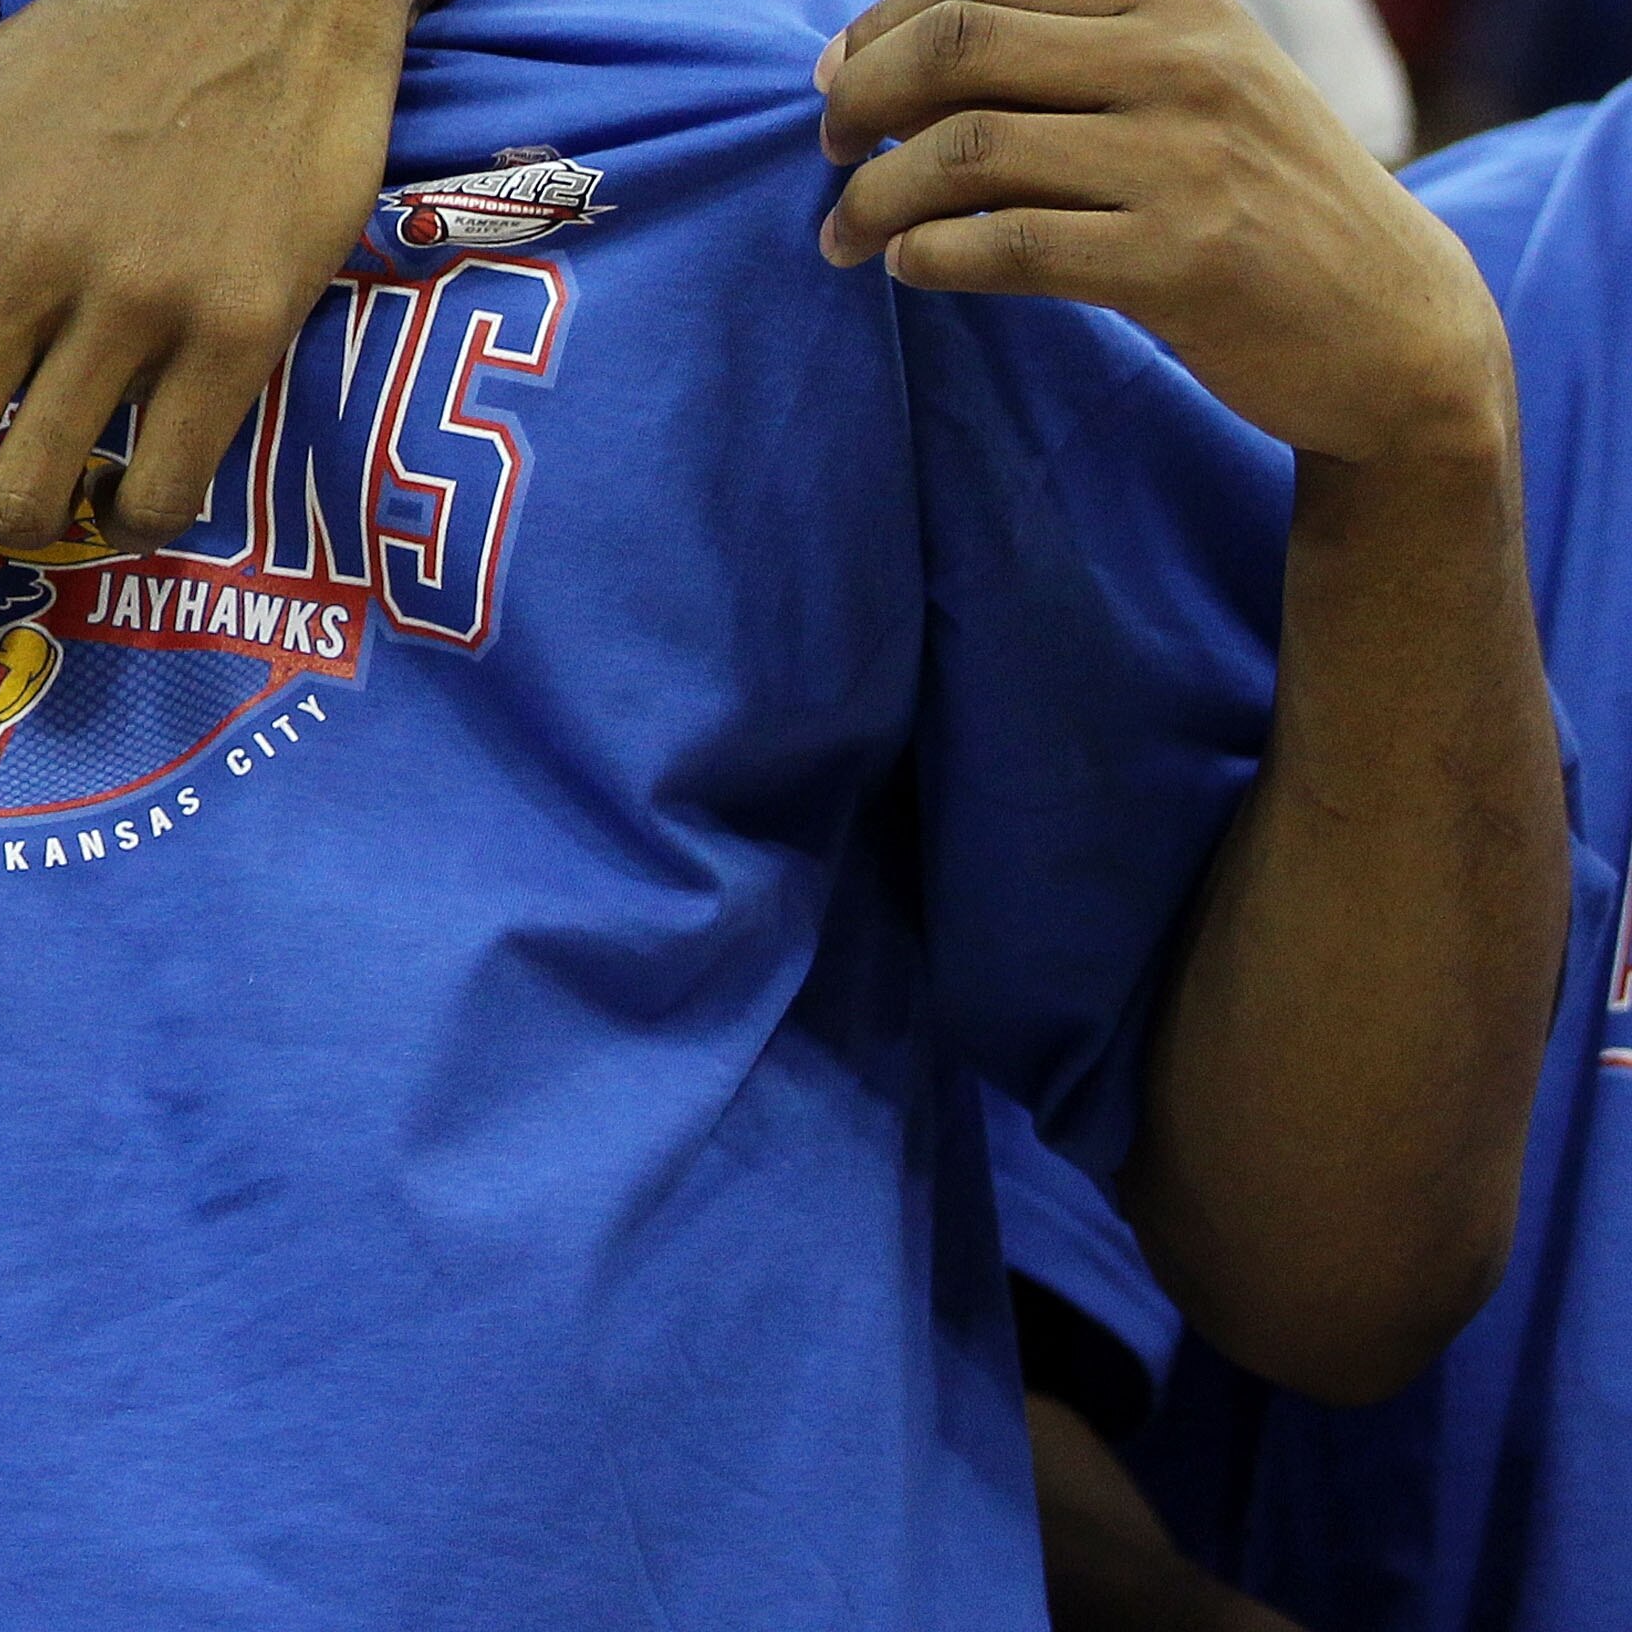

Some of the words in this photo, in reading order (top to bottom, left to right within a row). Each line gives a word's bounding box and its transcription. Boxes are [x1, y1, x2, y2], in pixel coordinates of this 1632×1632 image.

[86, 570, 350, 661] JAYHAWKS
[2, 785, 203, 873] KANSAS
[224, 693, 328, 778] CITY
